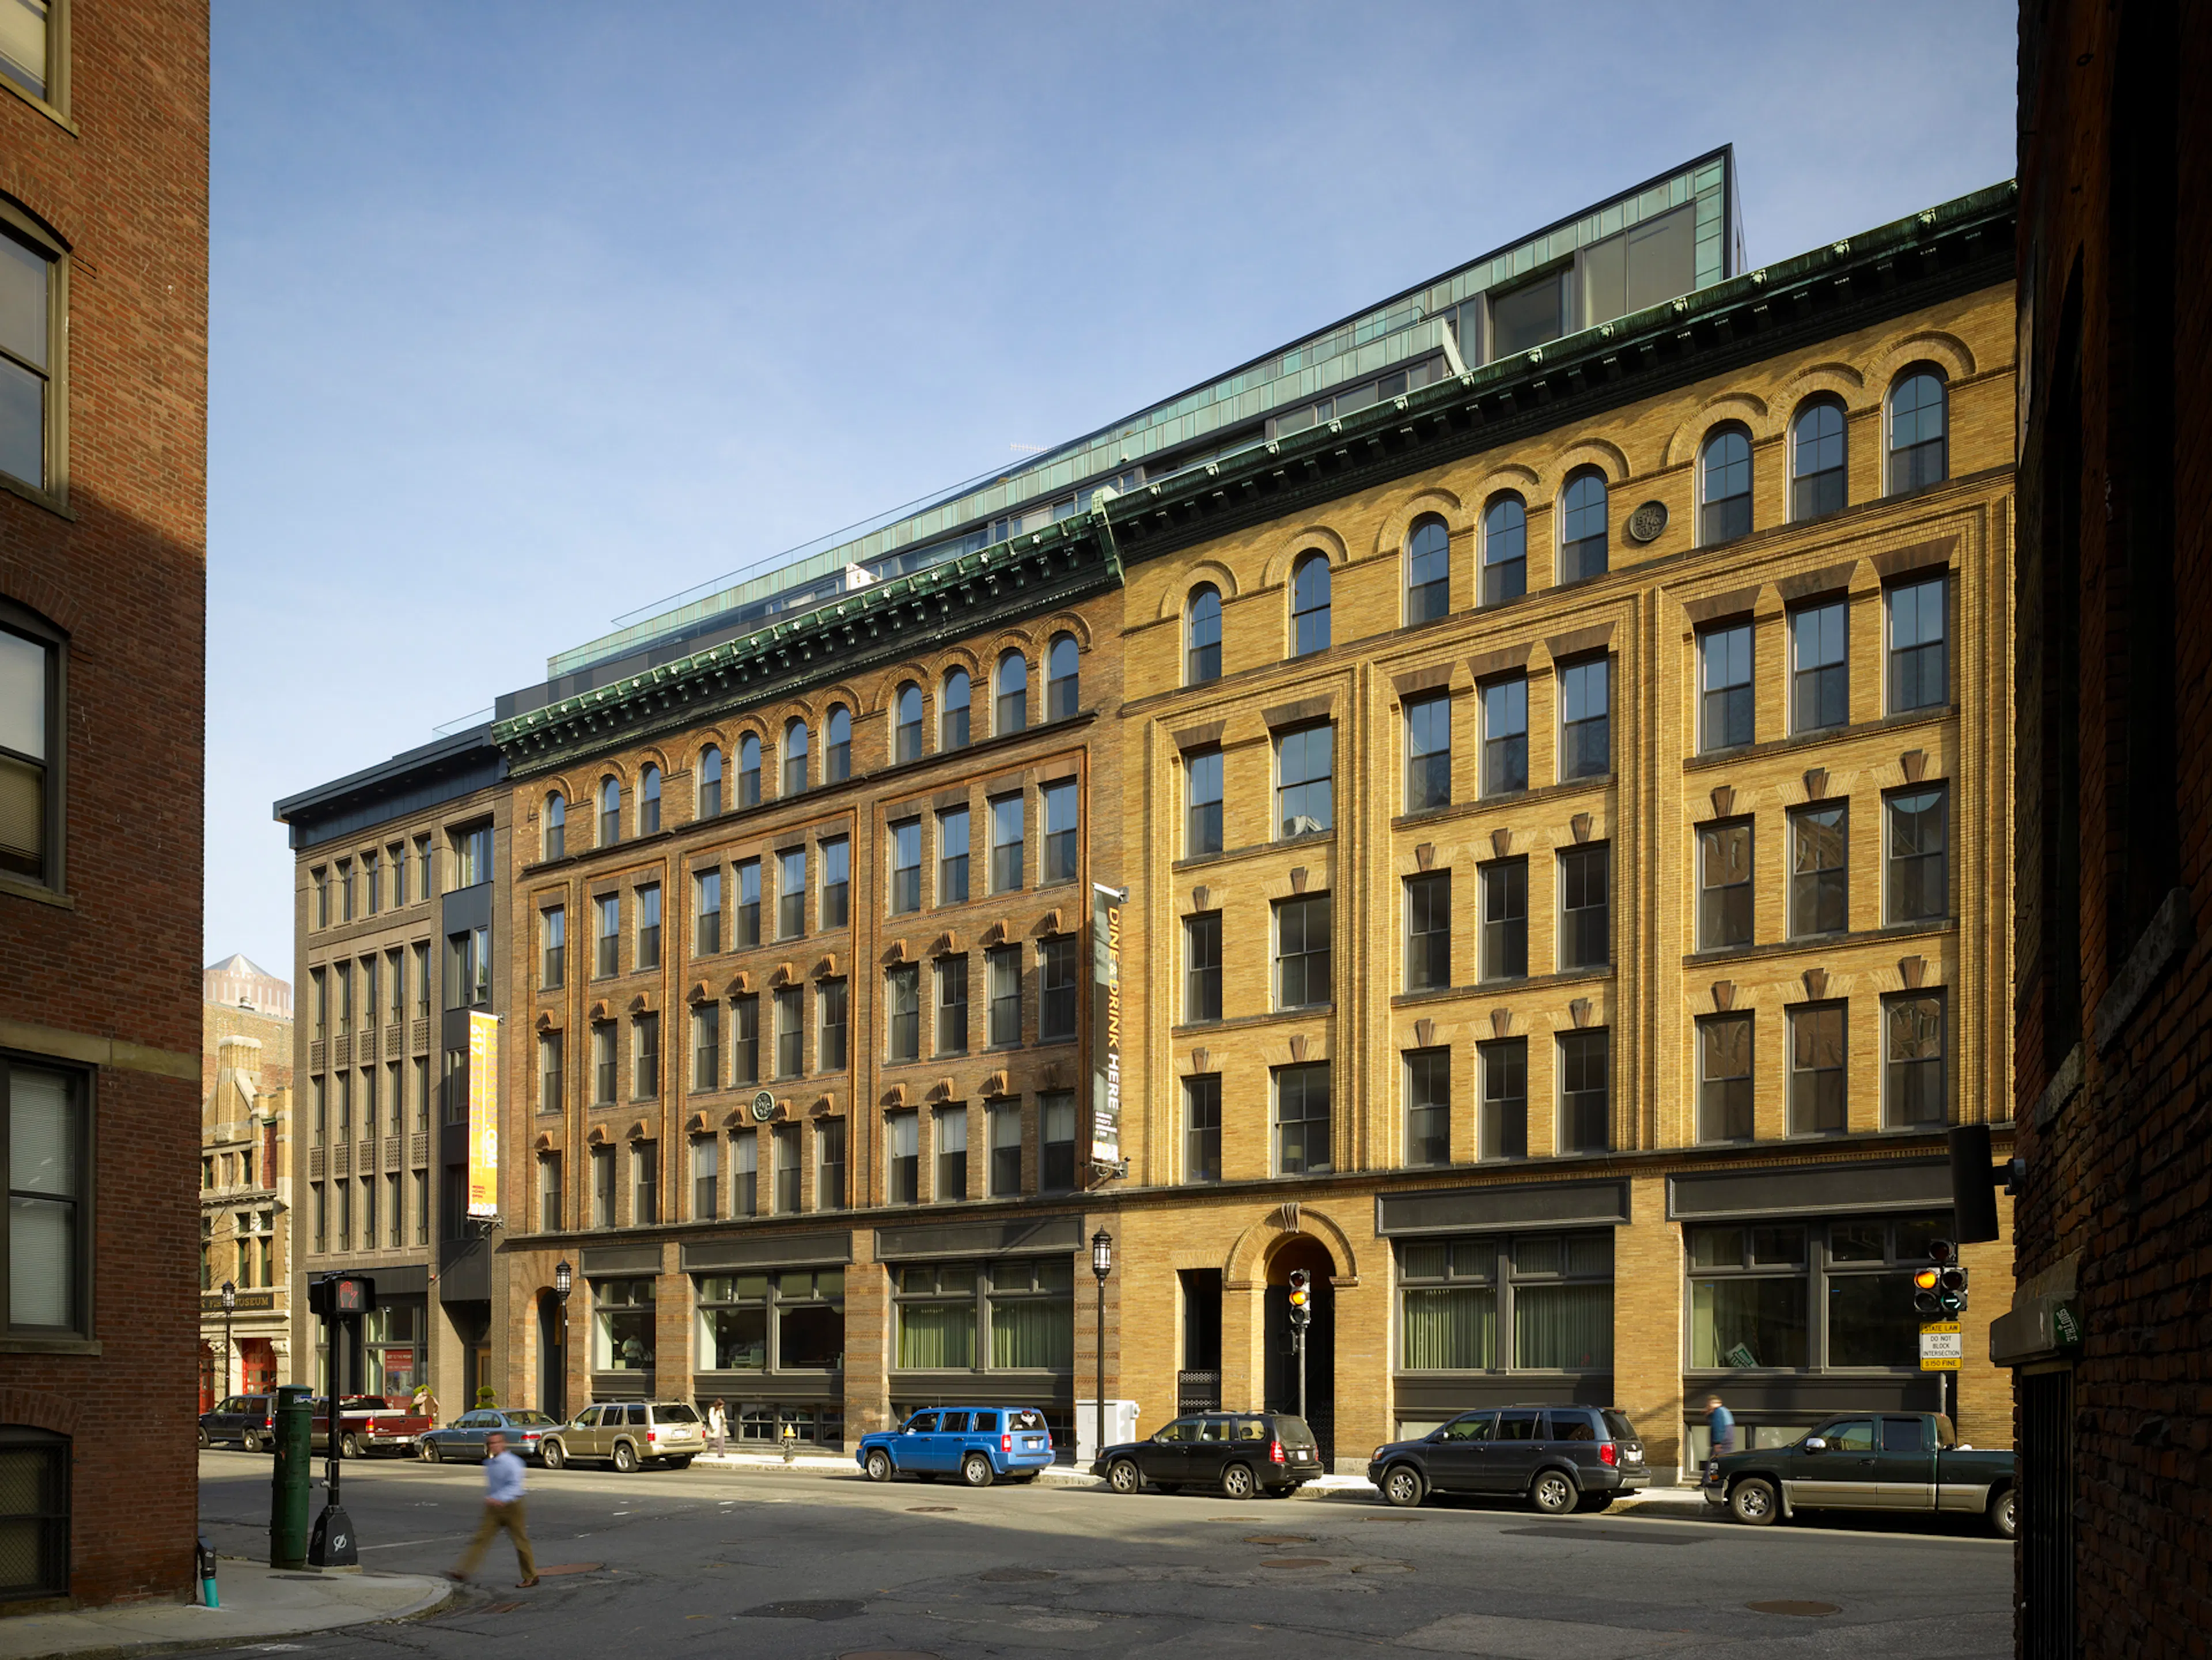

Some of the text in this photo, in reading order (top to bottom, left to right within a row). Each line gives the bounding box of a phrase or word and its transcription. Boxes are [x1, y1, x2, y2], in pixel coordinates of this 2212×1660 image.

[1108, 907, 1119, 1110] DINE & DRINK HERE
